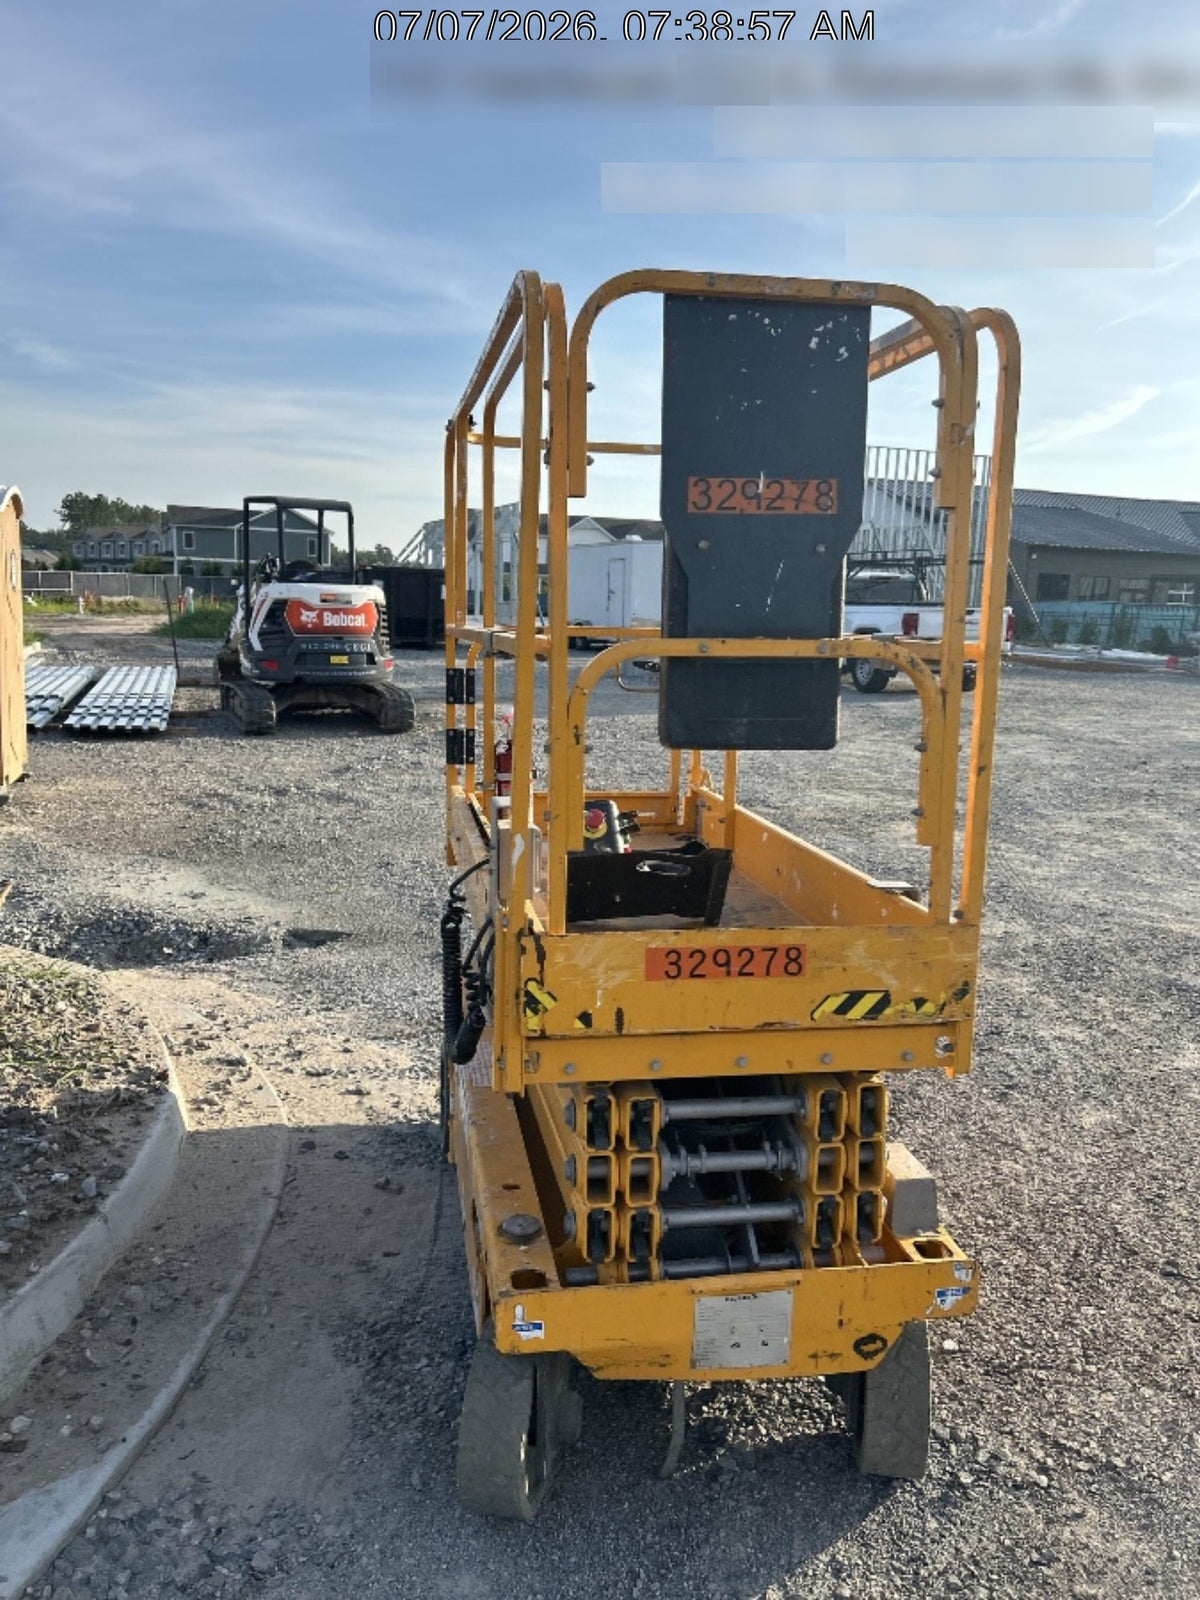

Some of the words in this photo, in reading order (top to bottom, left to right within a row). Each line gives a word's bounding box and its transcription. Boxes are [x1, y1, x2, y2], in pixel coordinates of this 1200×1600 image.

[691, 479, 835, 512] 329278
[323, 611, 366, 627] Bobcat
[664, 947, 804, 980] 329278
